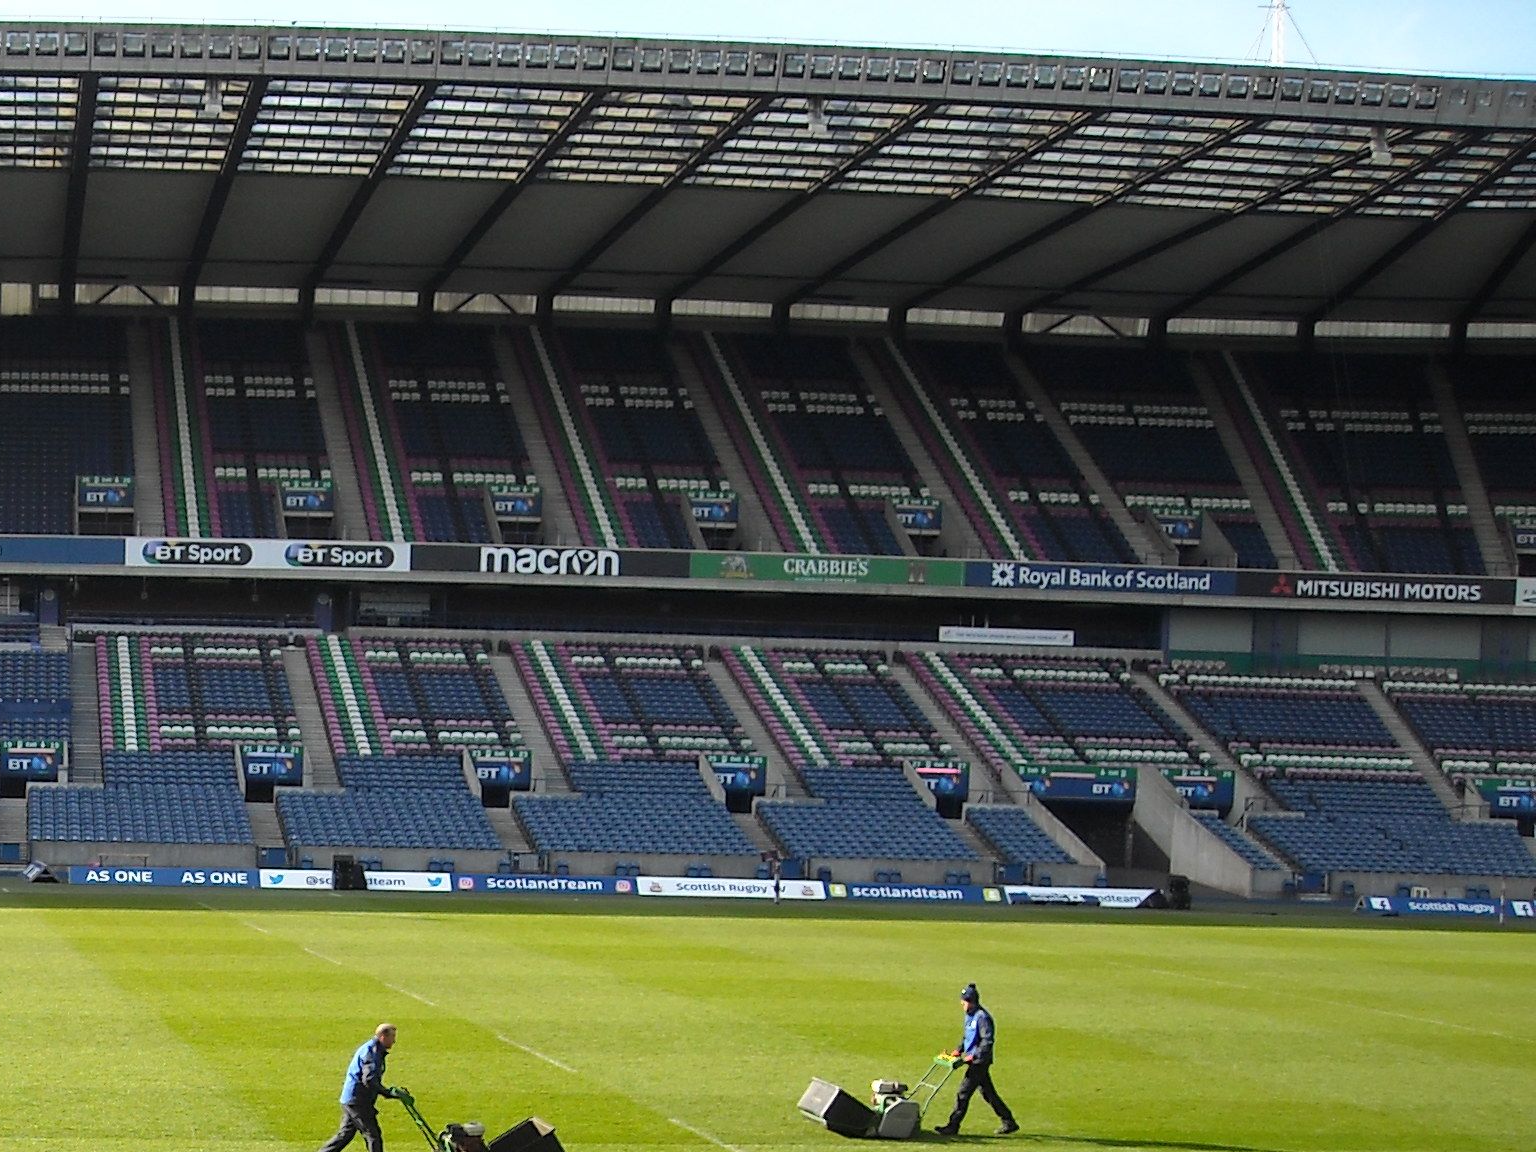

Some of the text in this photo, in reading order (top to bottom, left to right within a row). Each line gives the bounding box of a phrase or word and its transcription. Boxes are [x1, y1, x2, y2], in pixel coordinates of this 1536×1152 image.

[86, 491, 105, 503] BT
[286, 495, 305, 507] BT
[494, 500, 514, 512] BT
[693, 506, 711, 517] BT
[155, 544, 241, 565] BT Sport
[297, 546, 383, 566] BT Sport
[480, 548, 619, 576] macron
[783, 558, 869, 576] CRABBIE'S
[1019, 568, 1210, 591] Royal Bank of Scotland
[1297, 581, 1481, 601] MITSUBISHI MOTORS
[8, 759, 31, 770] BT
[249, 763, 270, 775] BT
[477, 767, 499, 779] BT
[1092, 784, 1111, 795] BT
[1499, 796, 1520, 808] BT
[86, 871, 153, 882] AS ONE
[182, 872, 248, 884] AS ONE
[486, 878, 603, 891] ScotlandTeam
[676, 882, 725, 892] Scottish
[729, 884, 767, 894] Rugby
[852, 887, 963, 900] scotlandteam
[1409, 901, 1495, 914] Scottish Rugby
